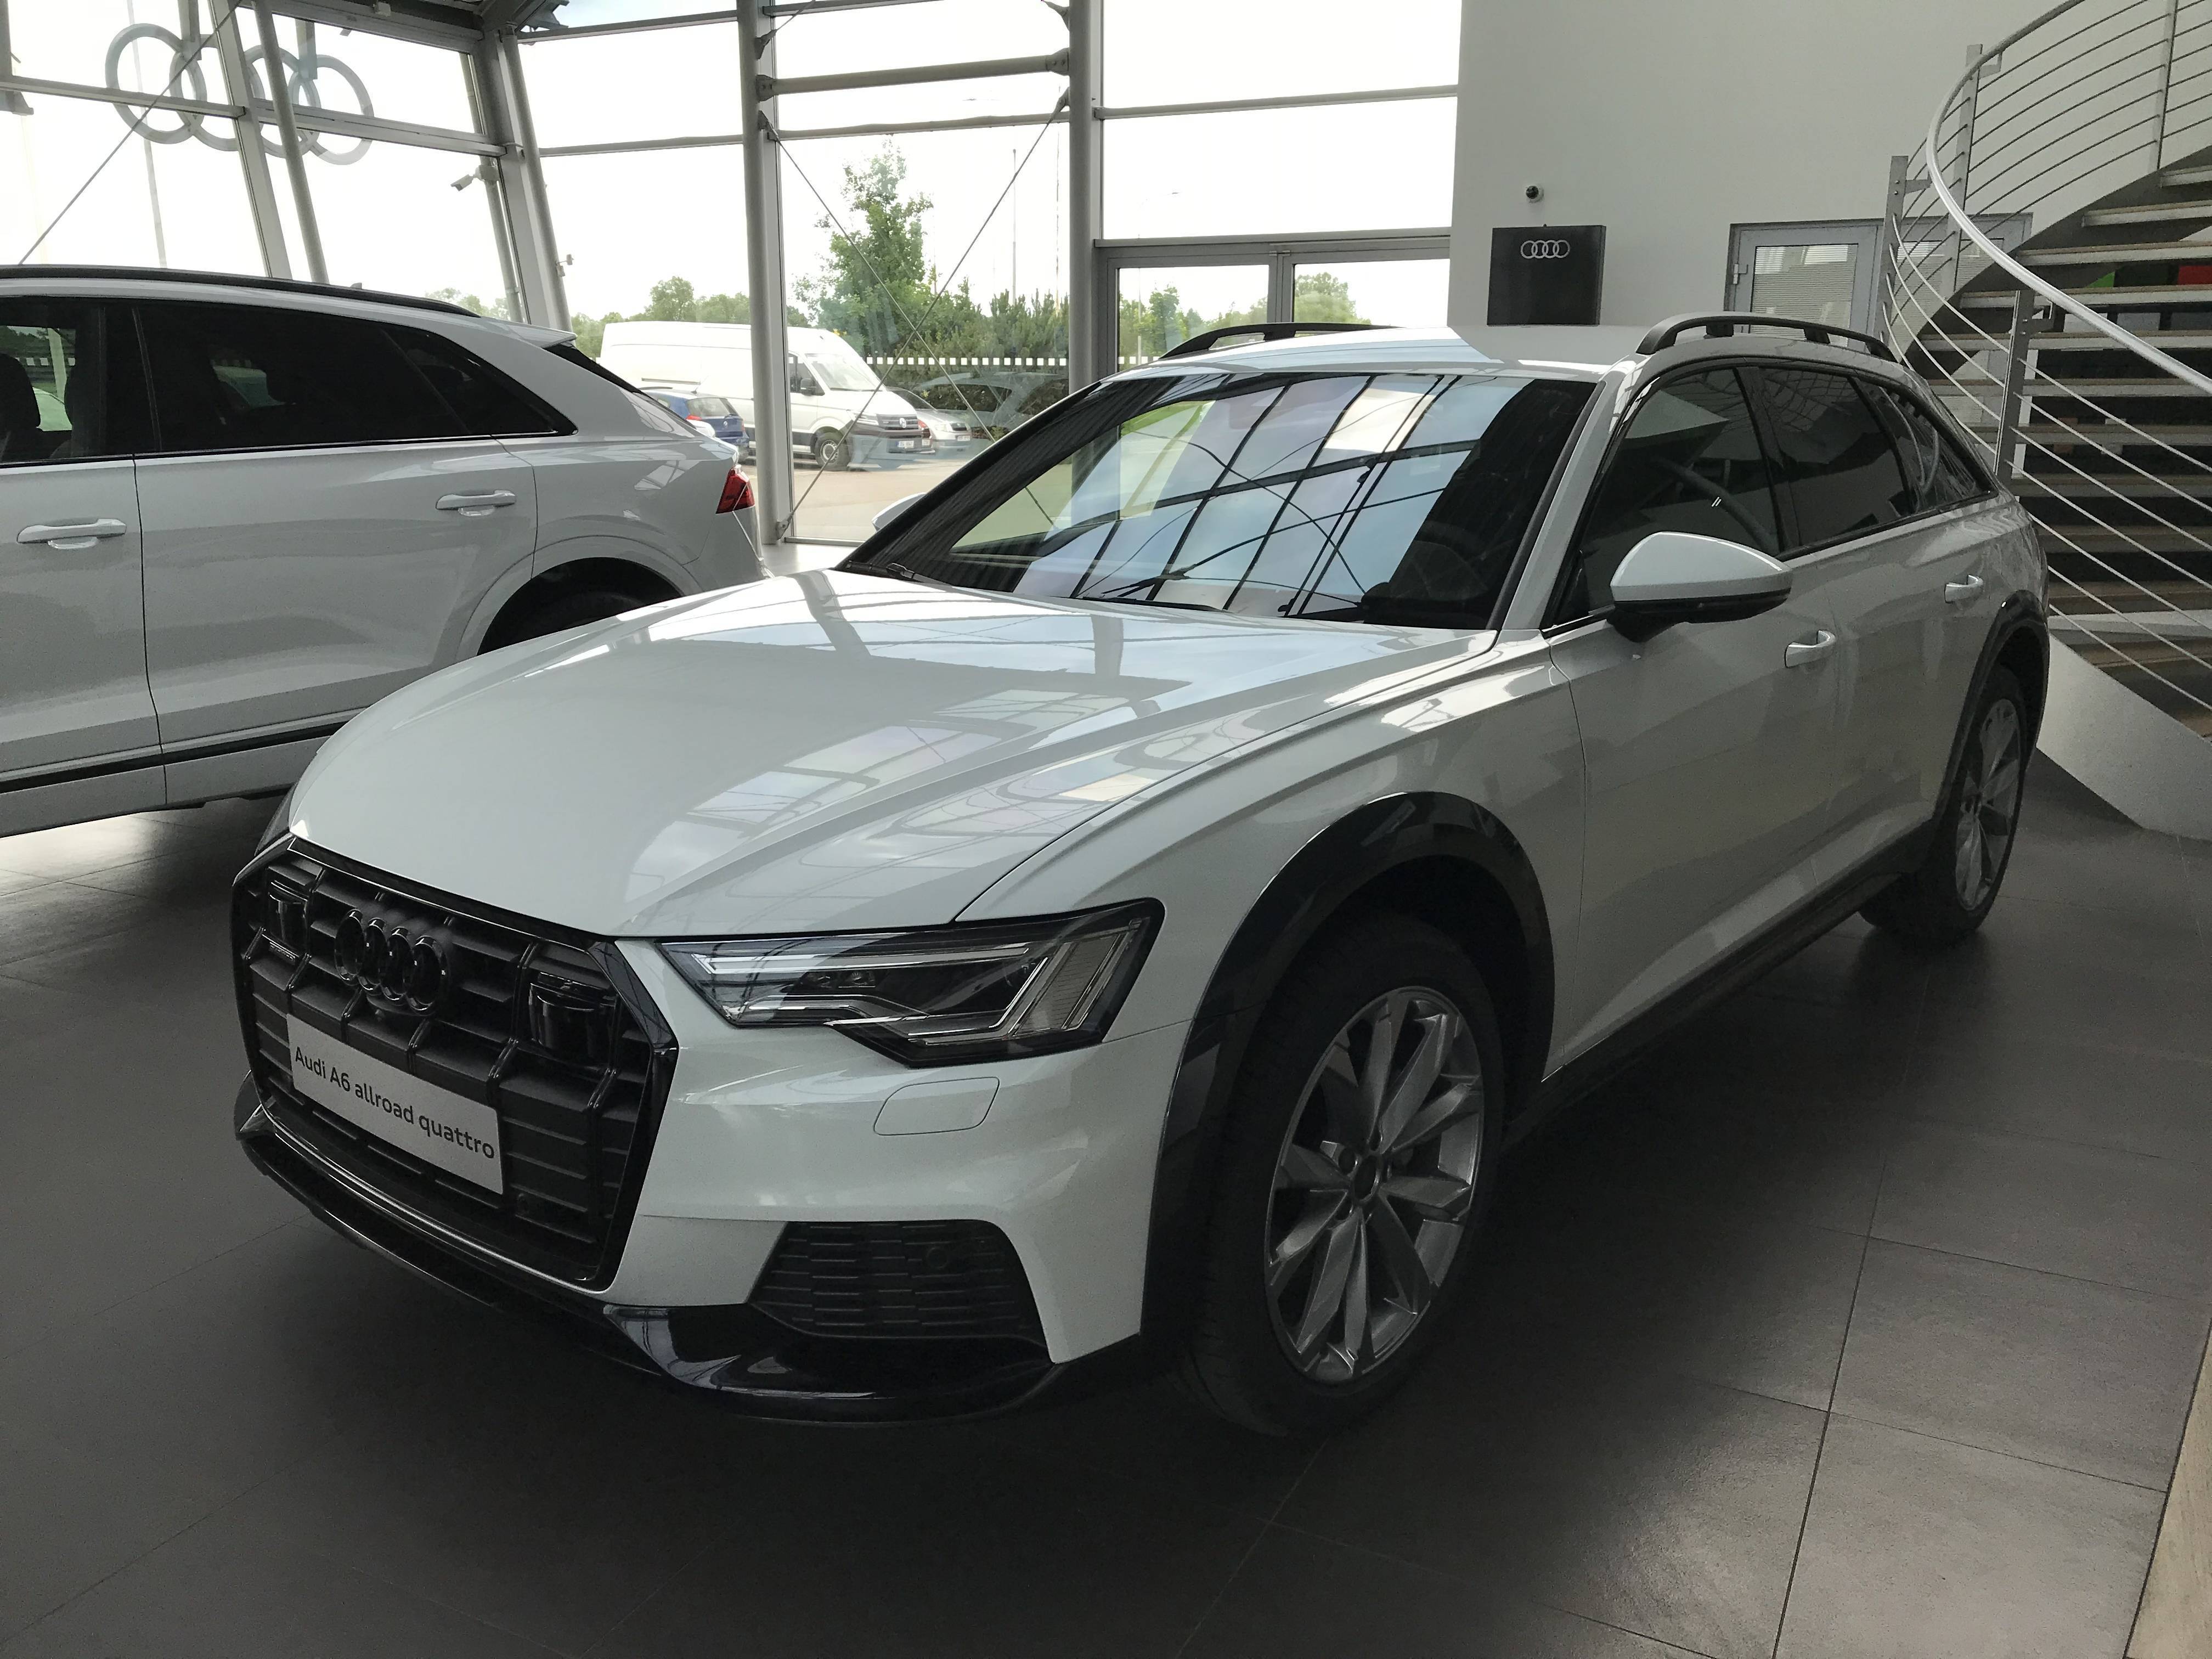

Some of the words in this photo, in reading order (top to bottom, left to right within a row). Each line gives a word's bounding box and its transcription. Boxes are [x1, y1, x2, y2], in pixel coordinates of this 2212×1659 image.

[295, 1046, 326, 1079] Audi
[330, 1066, 351, 1092] A6
[354, 1083, 414, 1125] allroad
[418, 1115, 495, 1159] quattro
